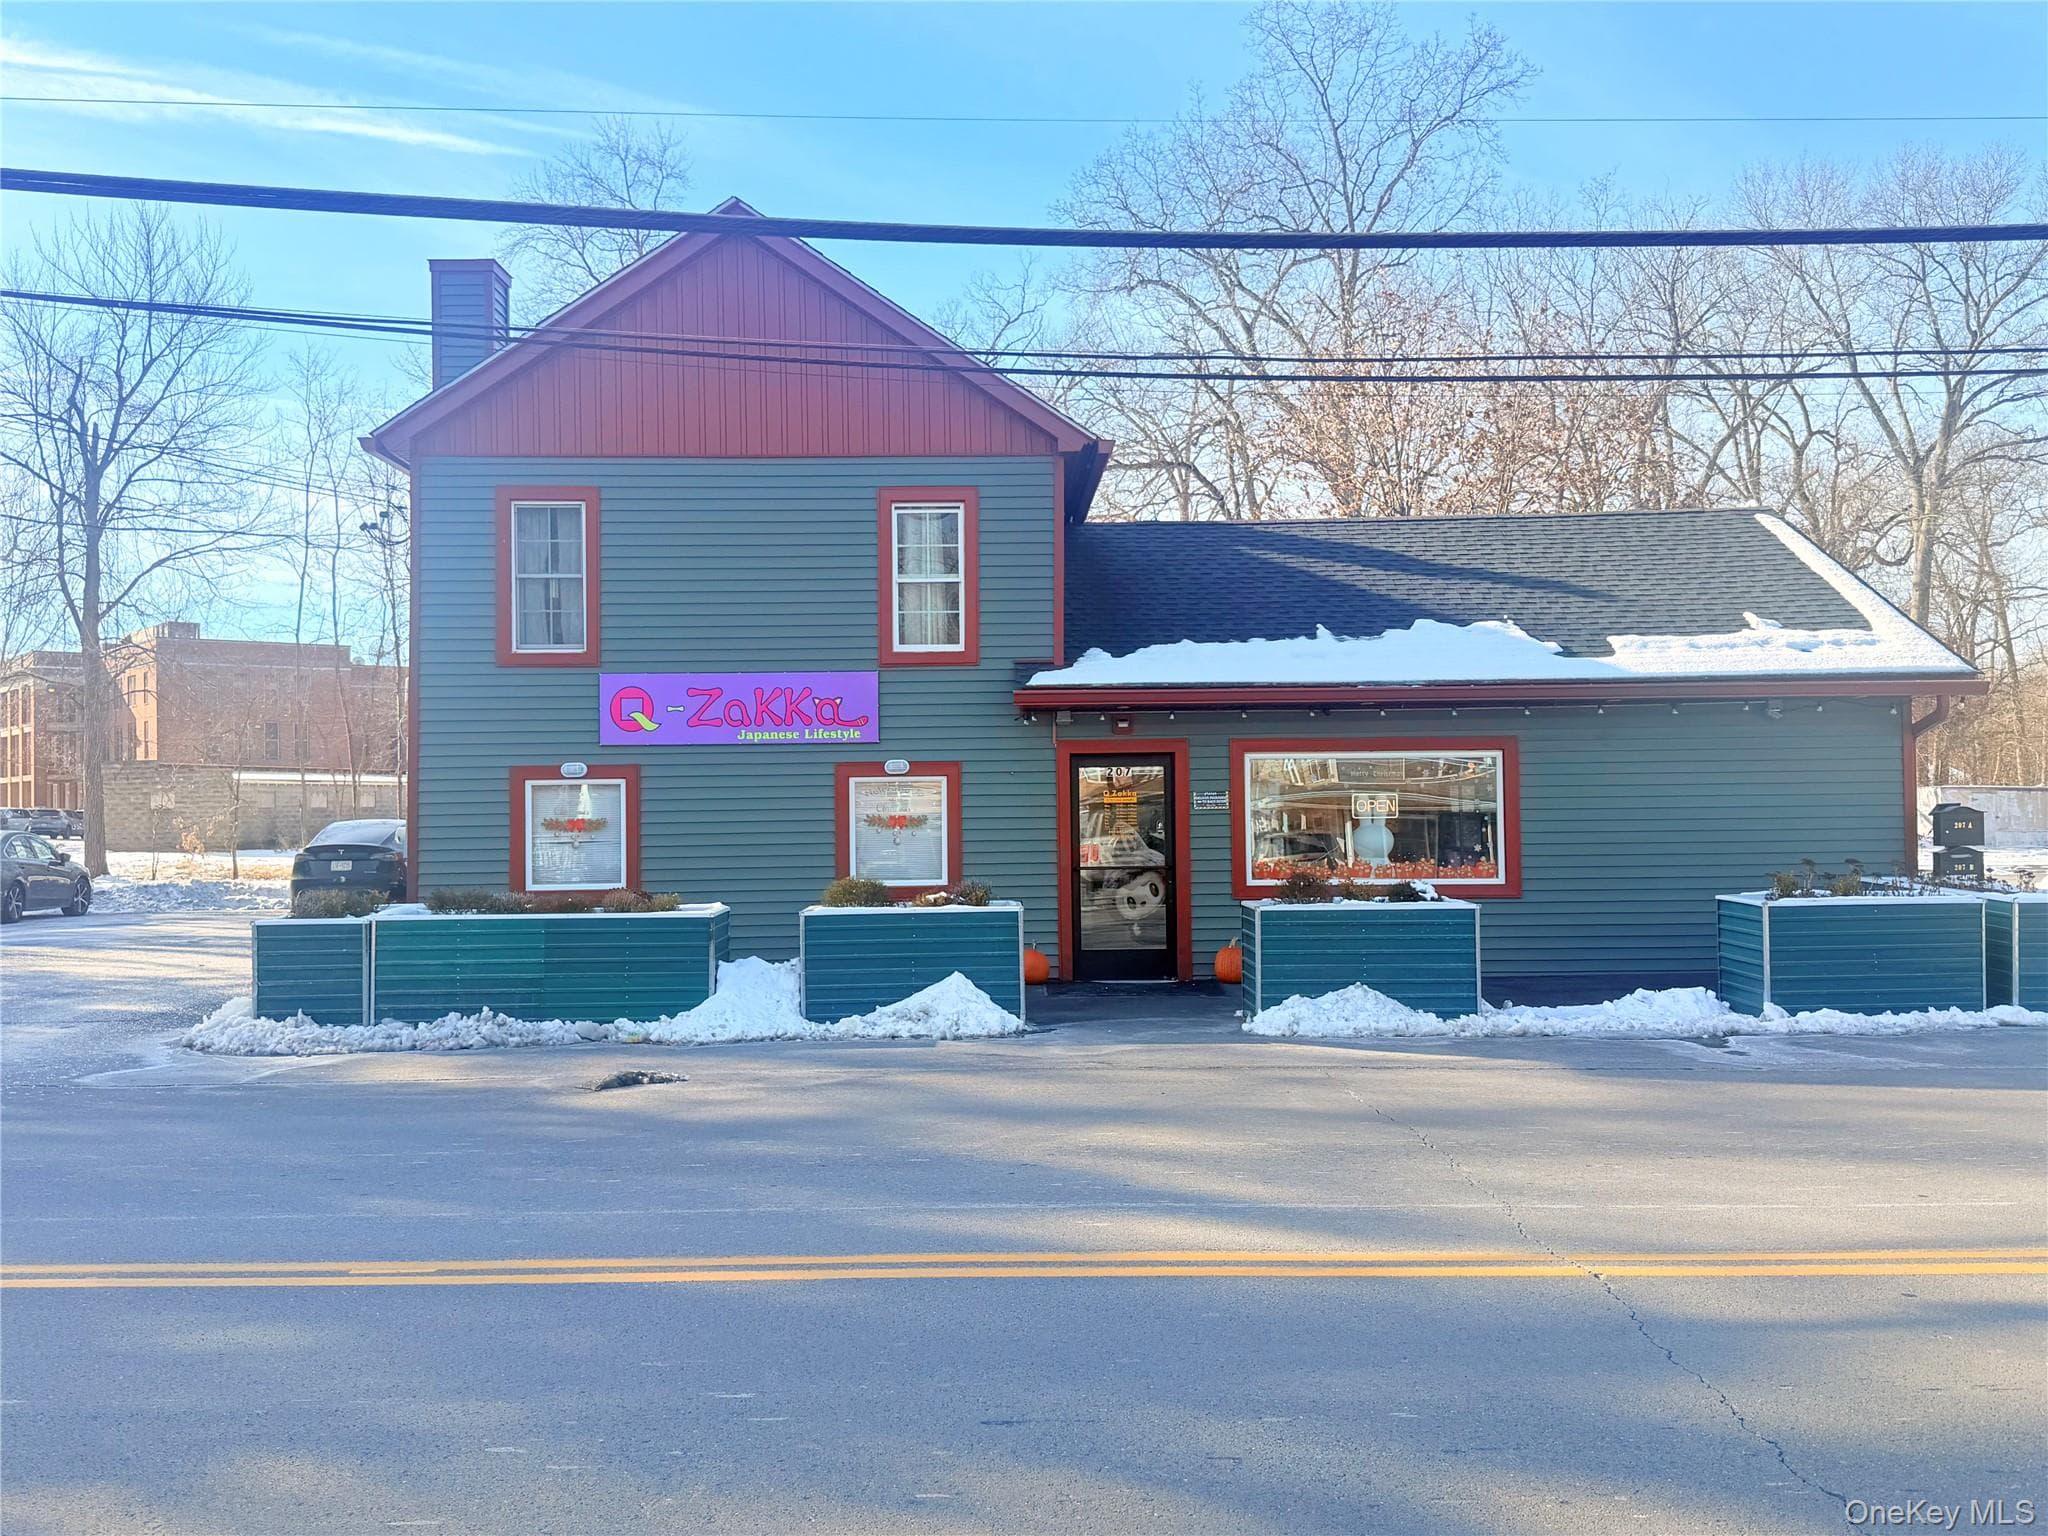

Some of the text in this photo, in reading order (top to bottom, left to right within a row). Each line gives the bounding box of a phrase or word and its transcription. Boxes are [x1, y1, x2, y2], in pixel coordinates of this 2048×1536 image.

[737, 728, 861, 741] Japanese Lifestyle
[1107, 767, 1131, 777] 207
[1356, 800, 1396, 812] OPEN
